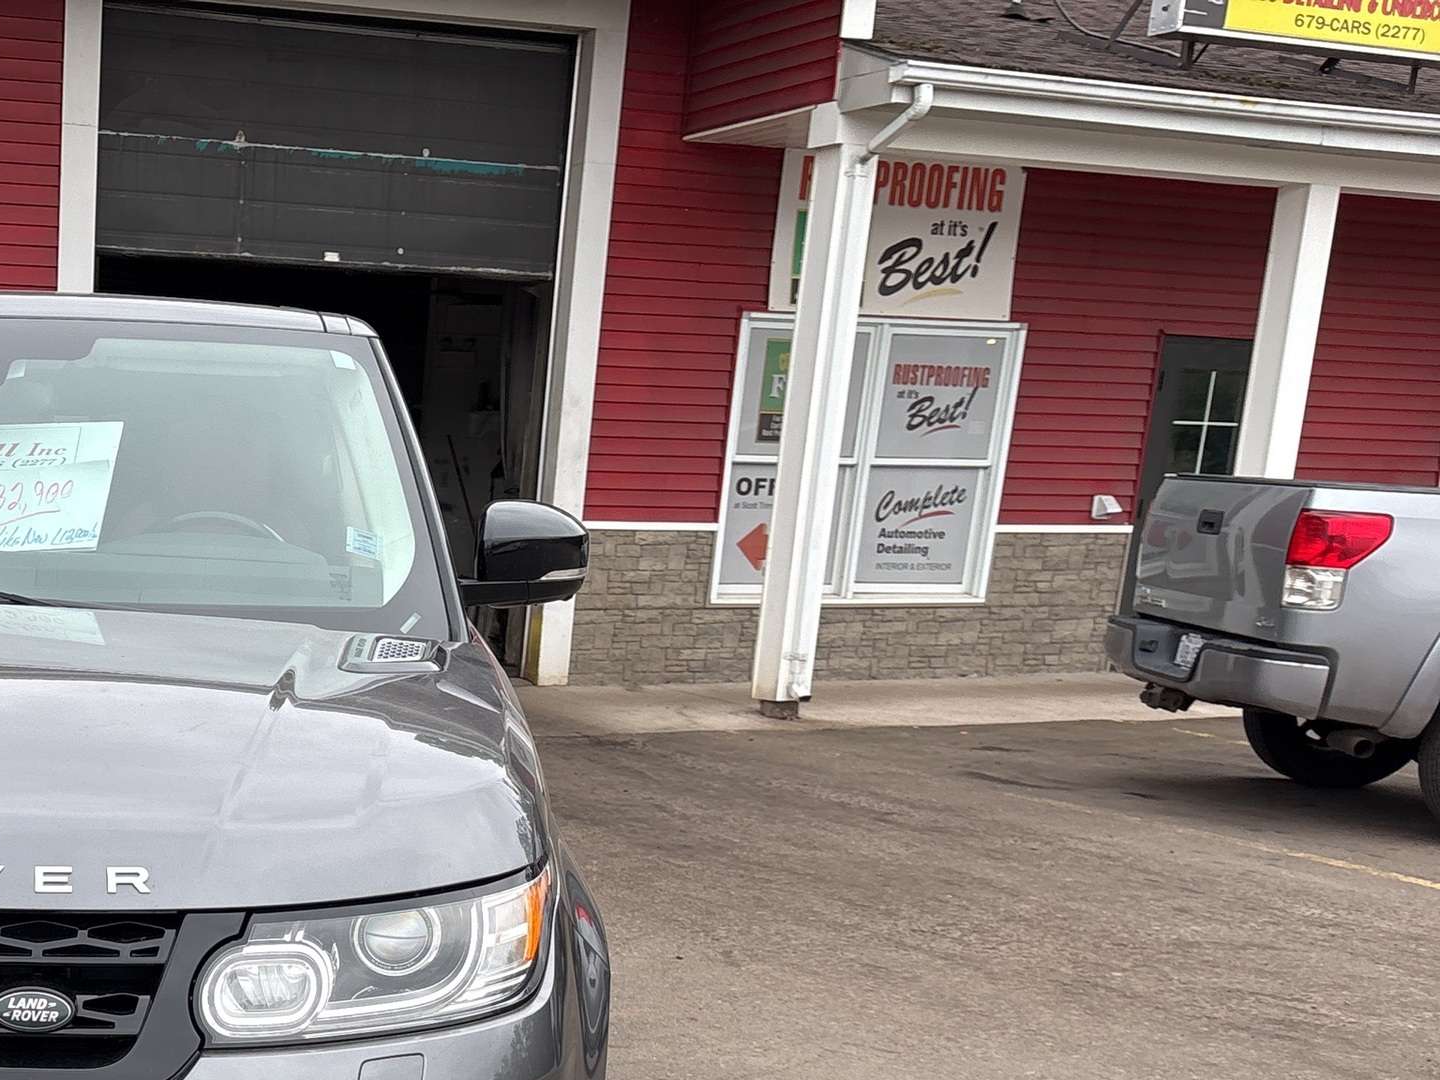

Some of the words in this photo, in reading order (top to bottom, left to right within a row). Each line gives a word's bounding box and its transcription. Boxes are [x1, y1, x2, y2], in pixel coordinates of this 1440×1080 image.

[1294, 13, 1372, 36] 679-CARS
[1375, 23, 1425, 45] (2277)
[930, 220, 946, 236] at
[948, 220, 968, 237] it's
[877, 221, 998, 297] Best!
[892, 363, 991, 388] RUSTPROOFING
[906, 386, 979, 431] Best!
[25, 442, 67, 457] Inc
[11, 456, 67, 469] (2277)
[874, 483, 968, 523] Complete
[877, 528, 946, 540] Automotive
[876, 542, 929, 557] Detailing
[7, 997, 48, 1010] LAND
[10, 1009, 60, 1023] ROVER
